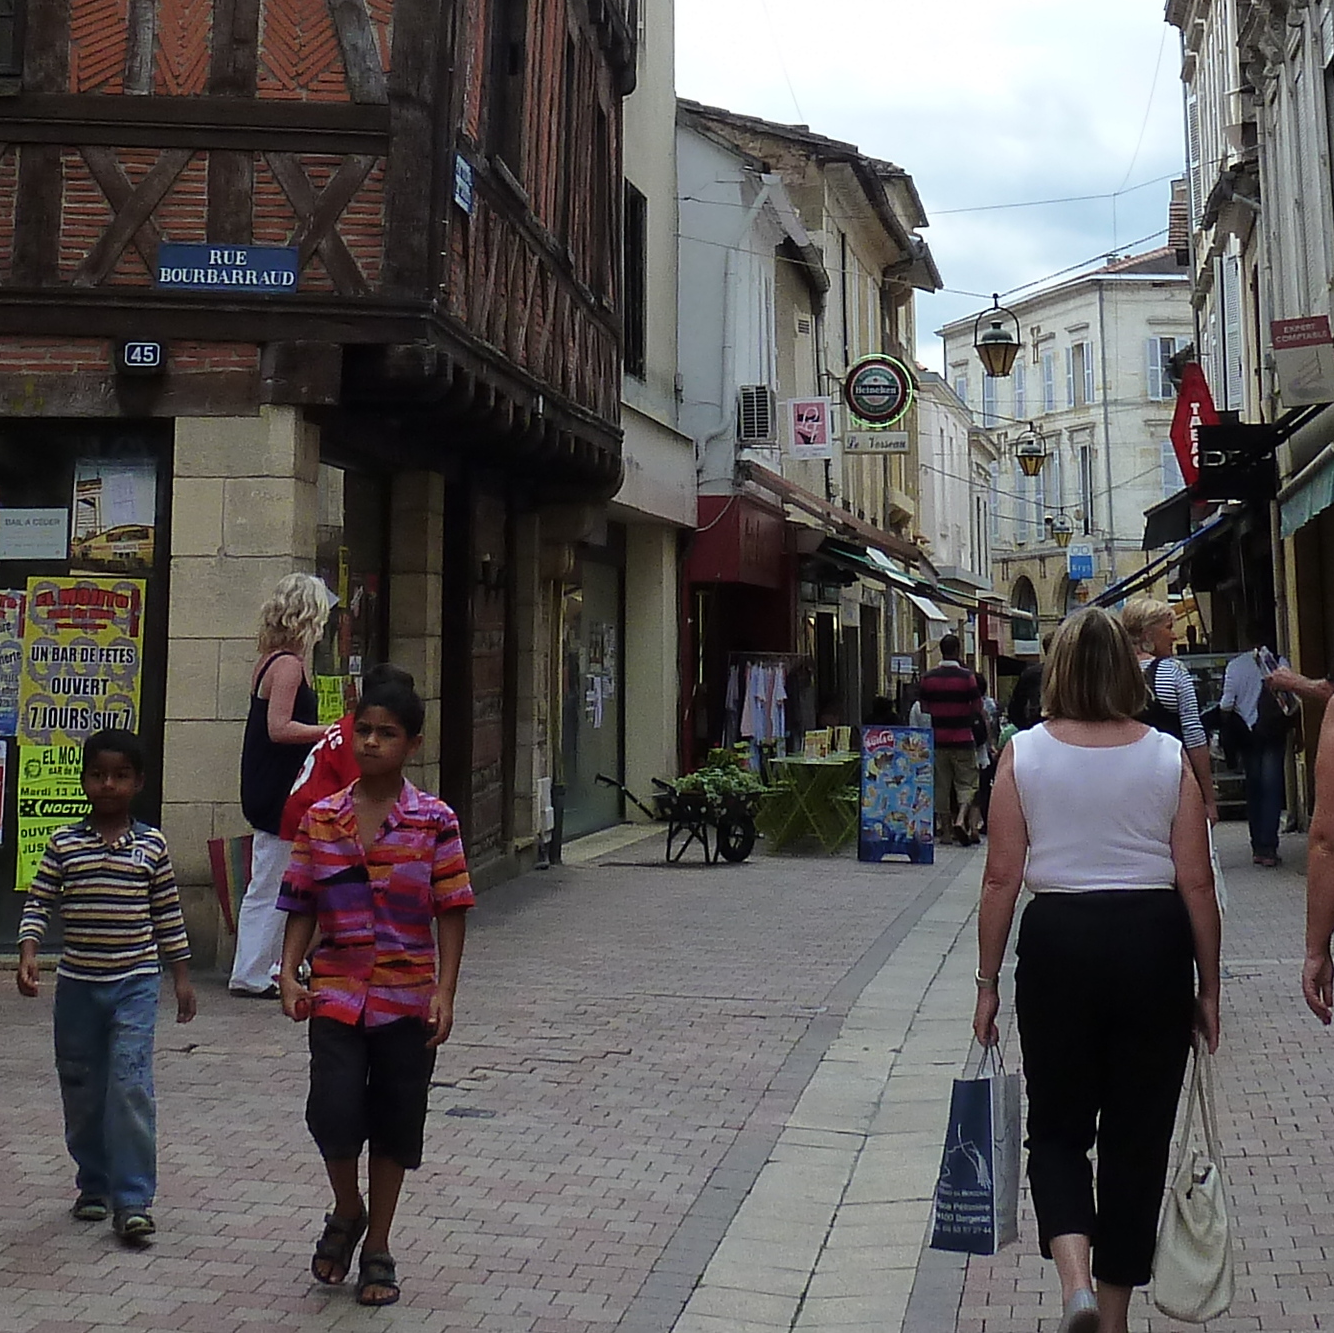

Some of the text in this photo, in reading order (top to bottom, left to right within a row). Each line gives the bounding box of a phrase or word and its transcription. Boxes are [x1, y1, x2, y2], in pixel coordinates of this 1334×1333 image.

[208, 249, 248, 266] RUE
[159, 267, 295, 287] BOURBARRAUD
[1275, 329, 1328, 343] COMPTABLE
[130, 346, 154, 363] 45
[854, 386, 897, 395] Heineken
[35, 587, 130, 609] EL MOJITO
[31, 646, 135, 664] UN BAR DE FETES
[51, 677, 110, 695] OUVERT
[29, 706, 131, 730] 7 JOURS sur 7
[42, 748, 56, 765] EL
[20, 787, 51, 797] Mardi
[55, 787, 68, 796] 13
[22, 843, 47, 854] JUS
